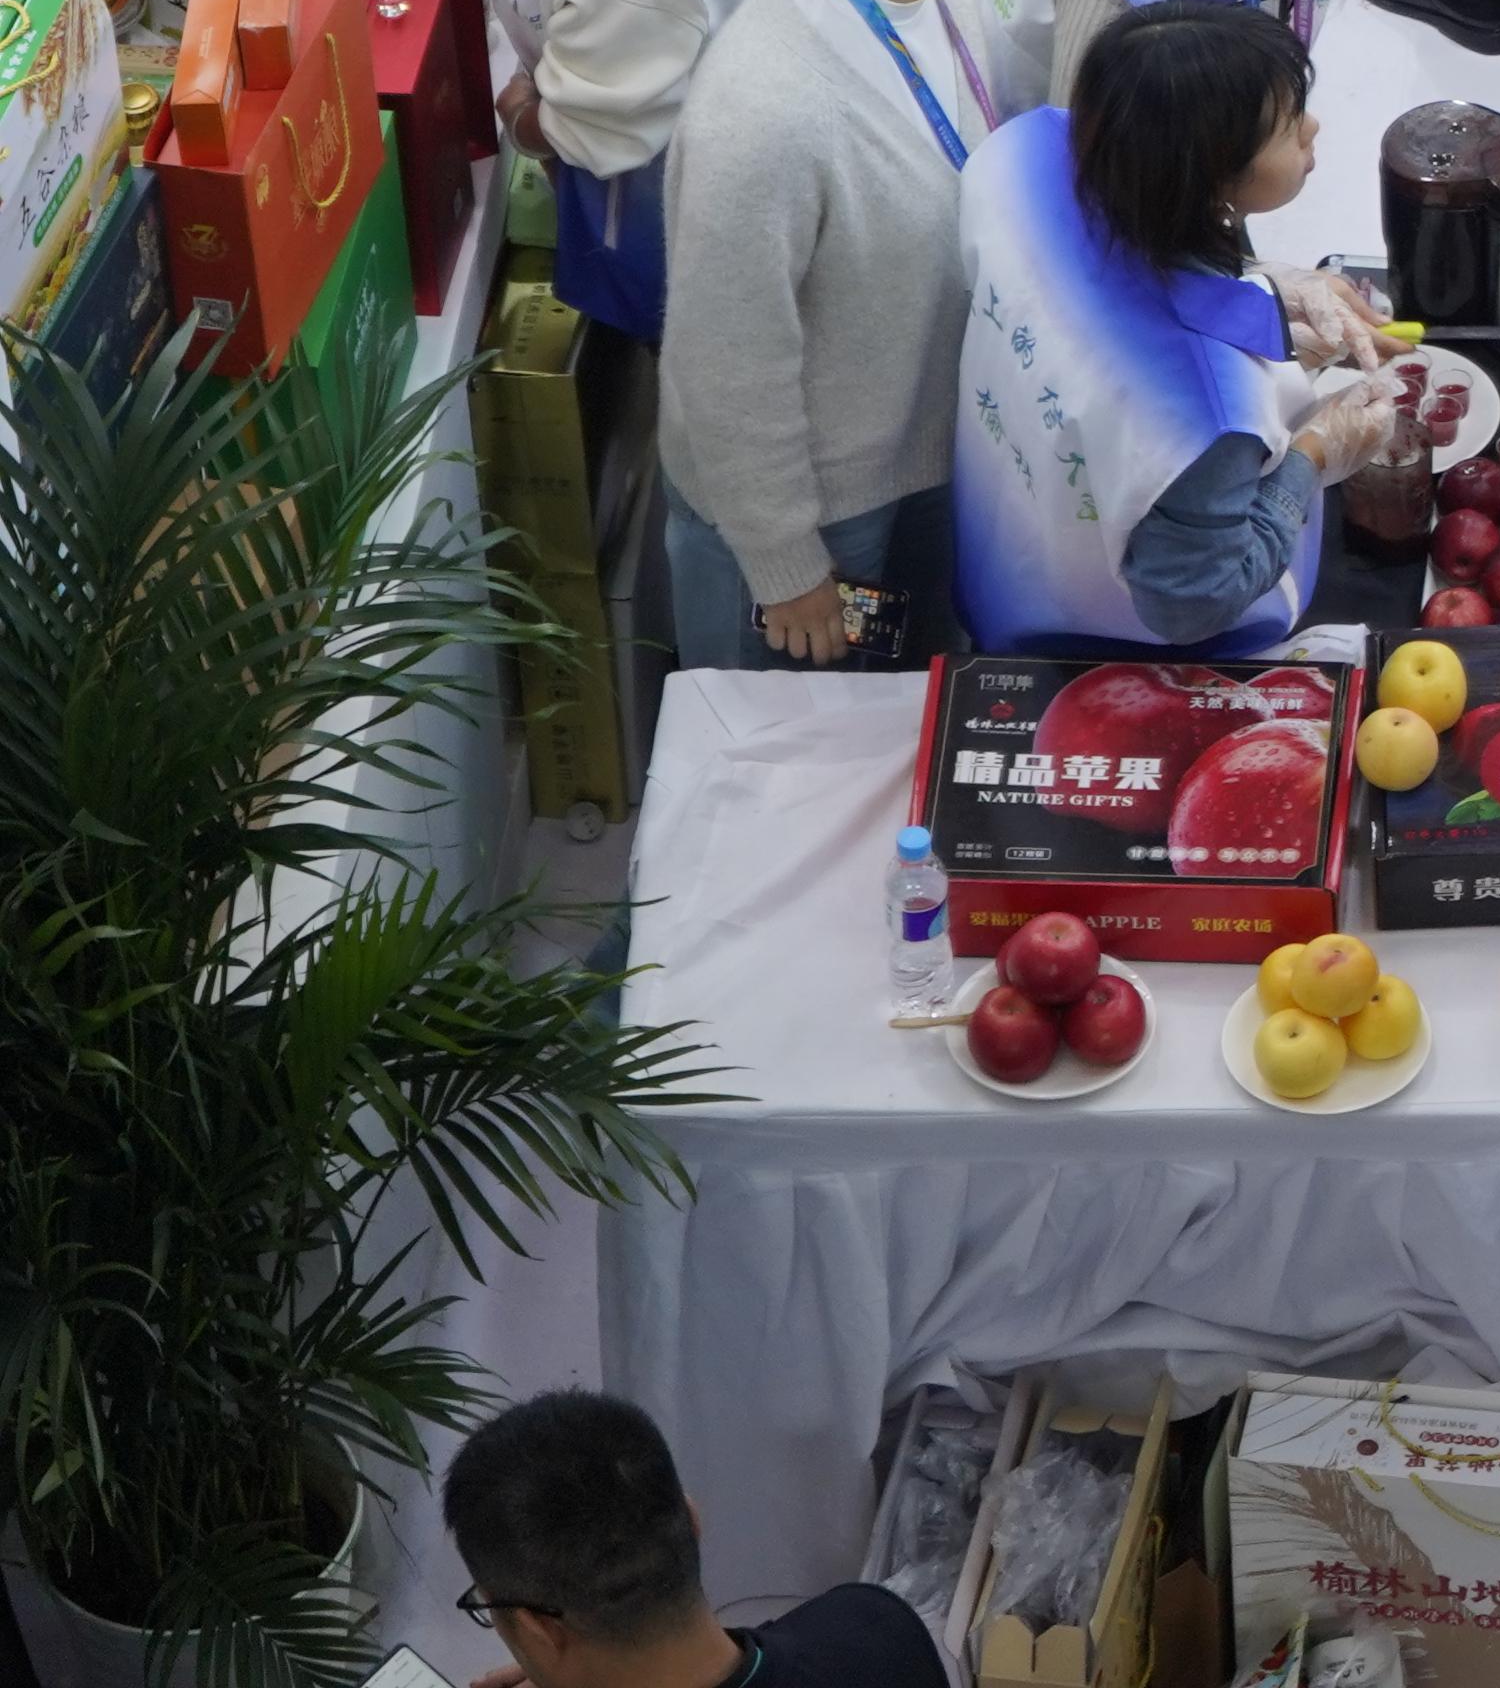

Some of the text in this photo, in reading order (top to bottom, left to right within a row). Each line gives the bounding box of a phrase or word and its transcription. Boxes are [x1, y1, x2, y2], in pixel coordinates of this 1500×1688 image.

[951, 749, 1168, 791] 精品苹果
[977, 789, 1135, 809] NATURE GIFTS
[1085, 914, 1162, 931] APPLE
